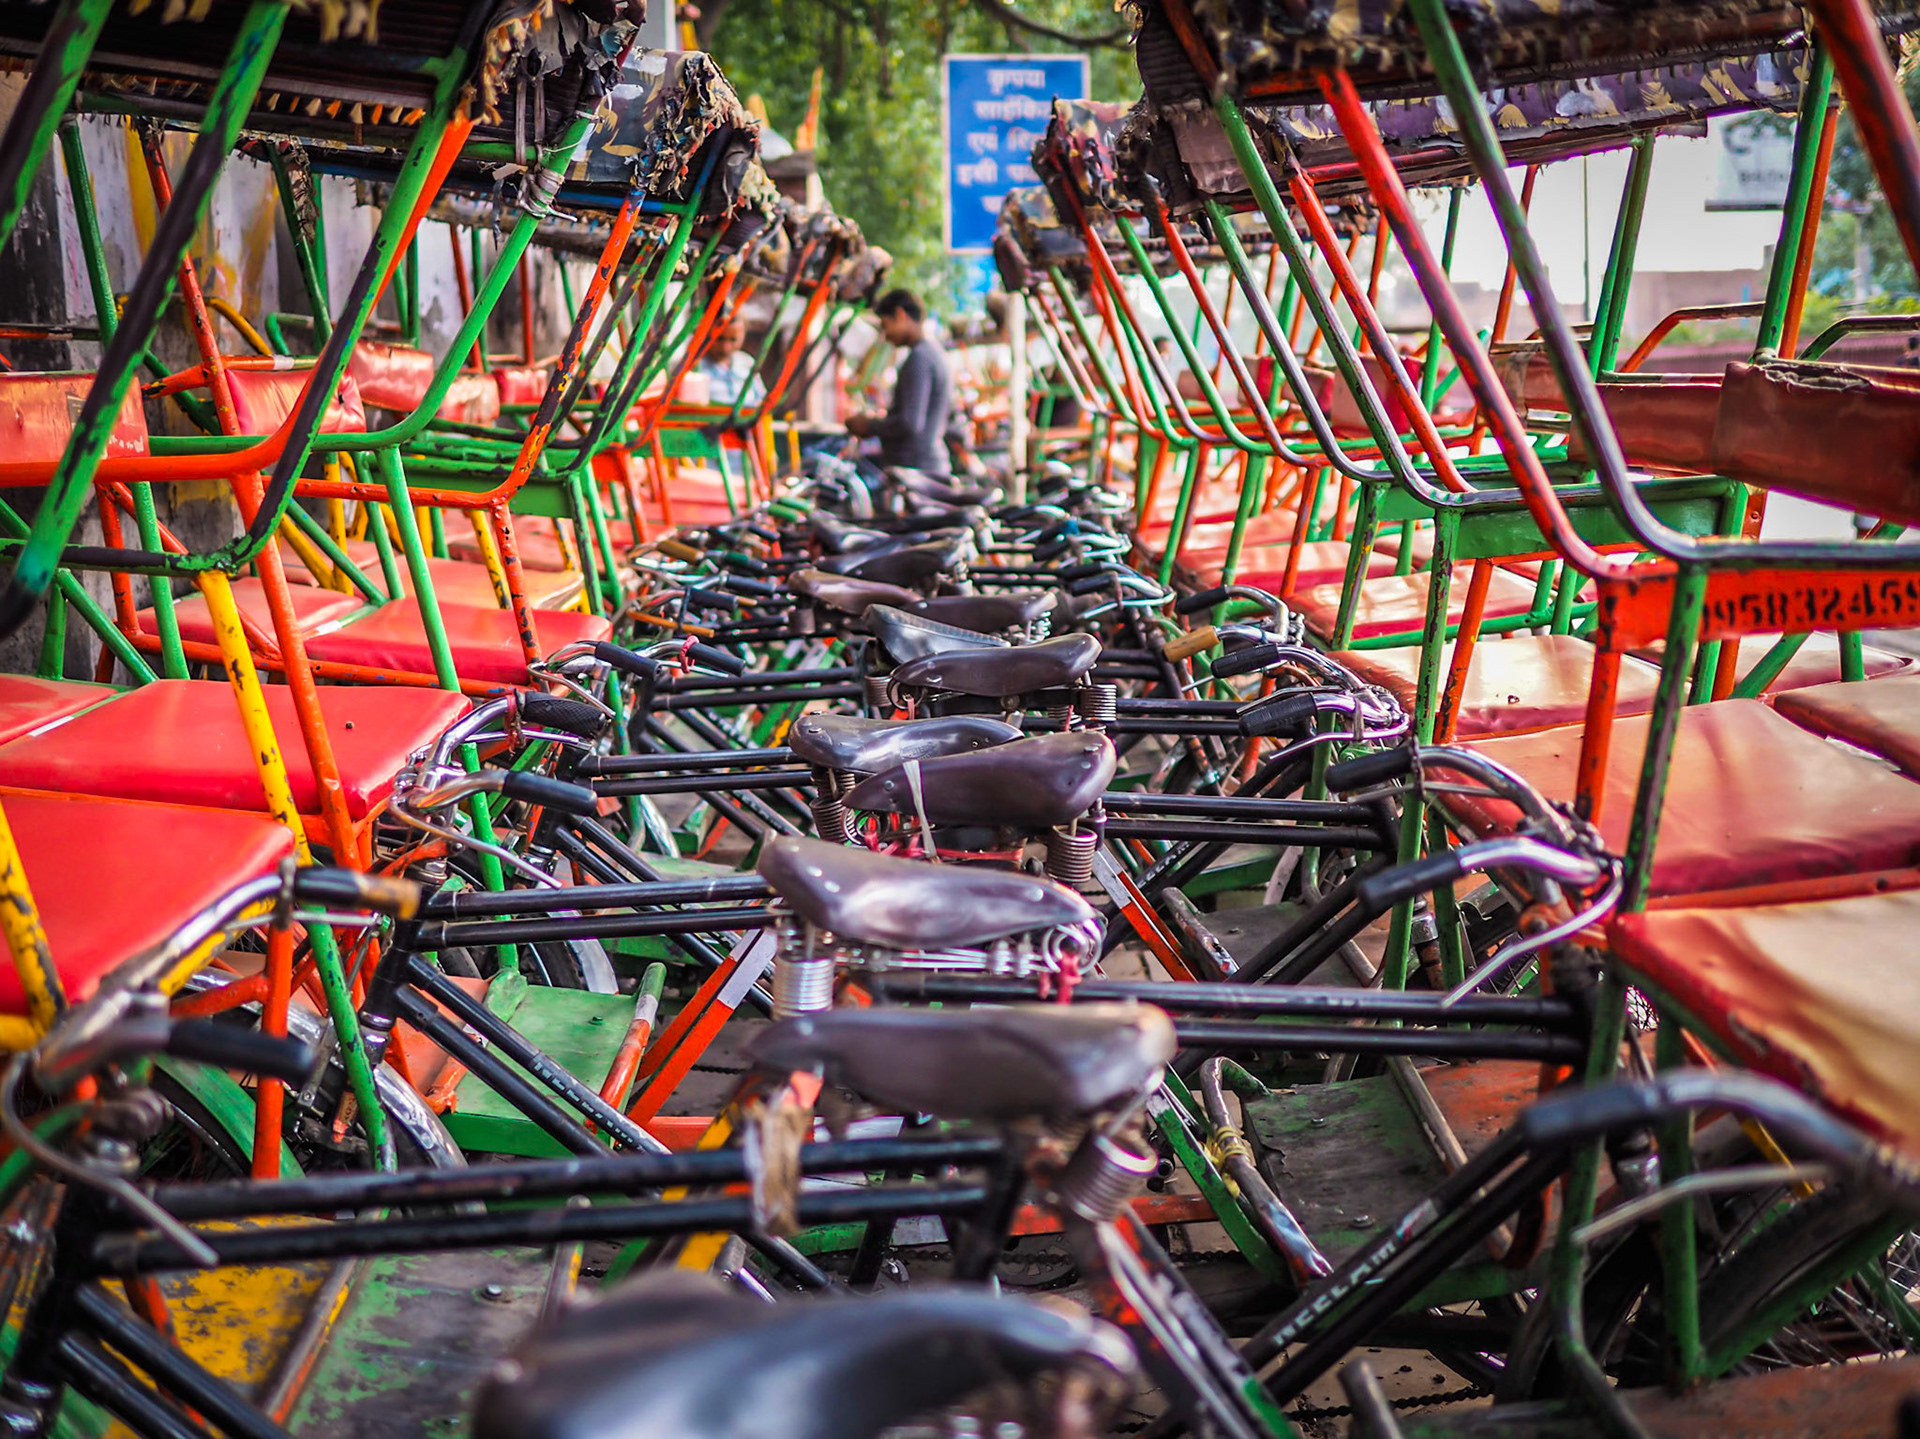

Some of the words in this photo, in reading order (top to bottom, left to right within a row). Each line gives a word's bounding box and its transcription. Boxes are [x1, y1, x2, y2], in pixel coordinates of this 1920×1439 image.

[986, 69, 1045, 94] कृपया
[968, 125, 998, 154] एवं
[1273, 1242, 1396, 1345] NEELAM
